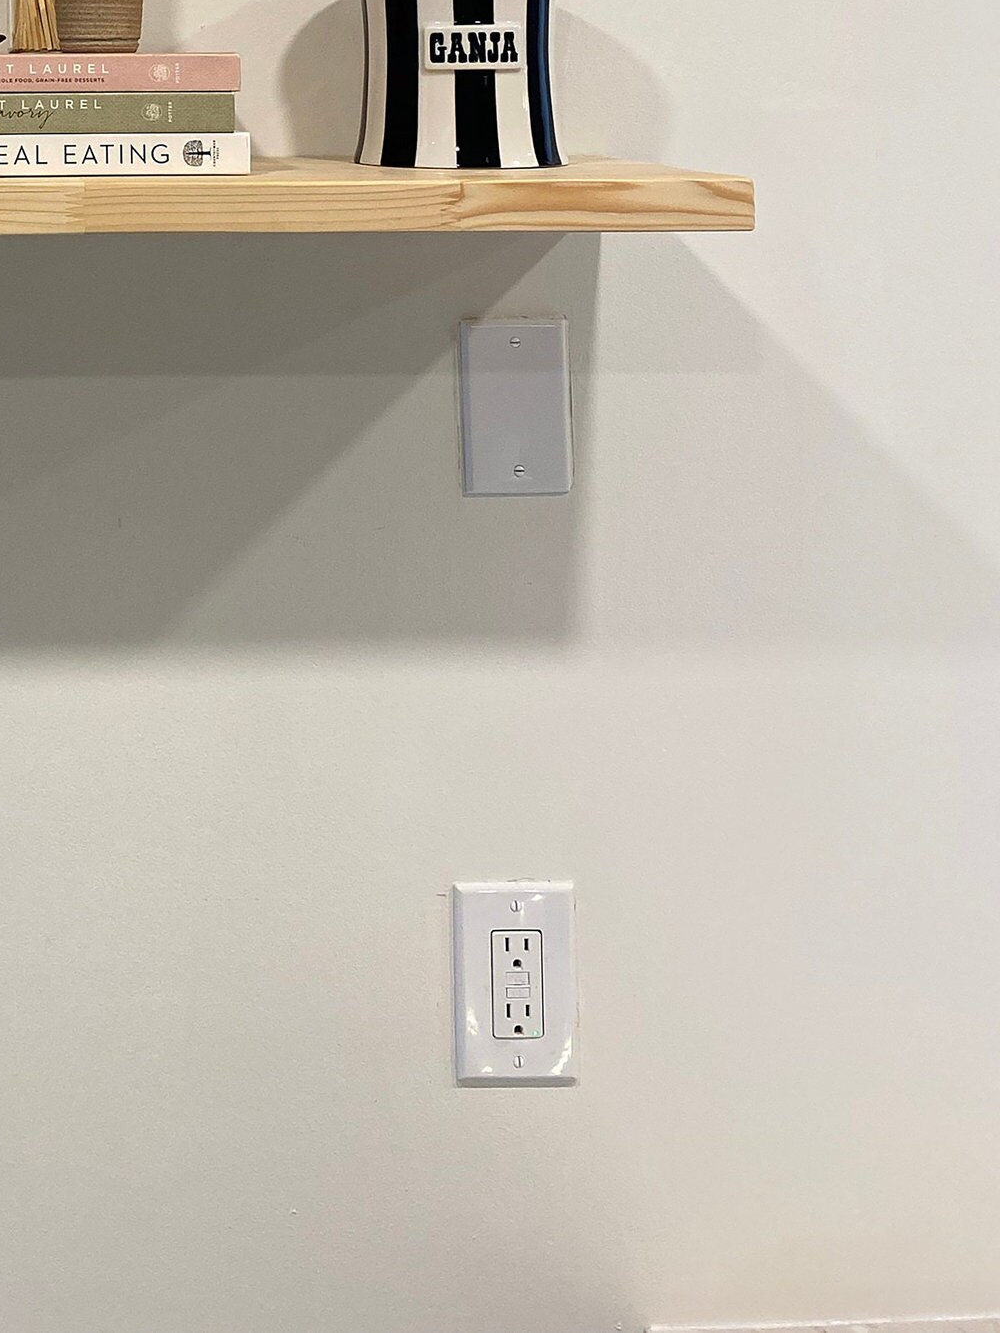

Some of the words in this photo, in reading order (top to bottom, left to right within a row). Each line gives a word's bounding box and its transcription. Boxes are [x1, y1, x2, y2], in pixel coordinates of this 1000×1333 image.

[429, 31, 519, 64] GANJA
[29, 63, 109, 74] LAUREL
[21, 99, 101, 110] LAUREL
[64, 143, 170, 165] EATING
